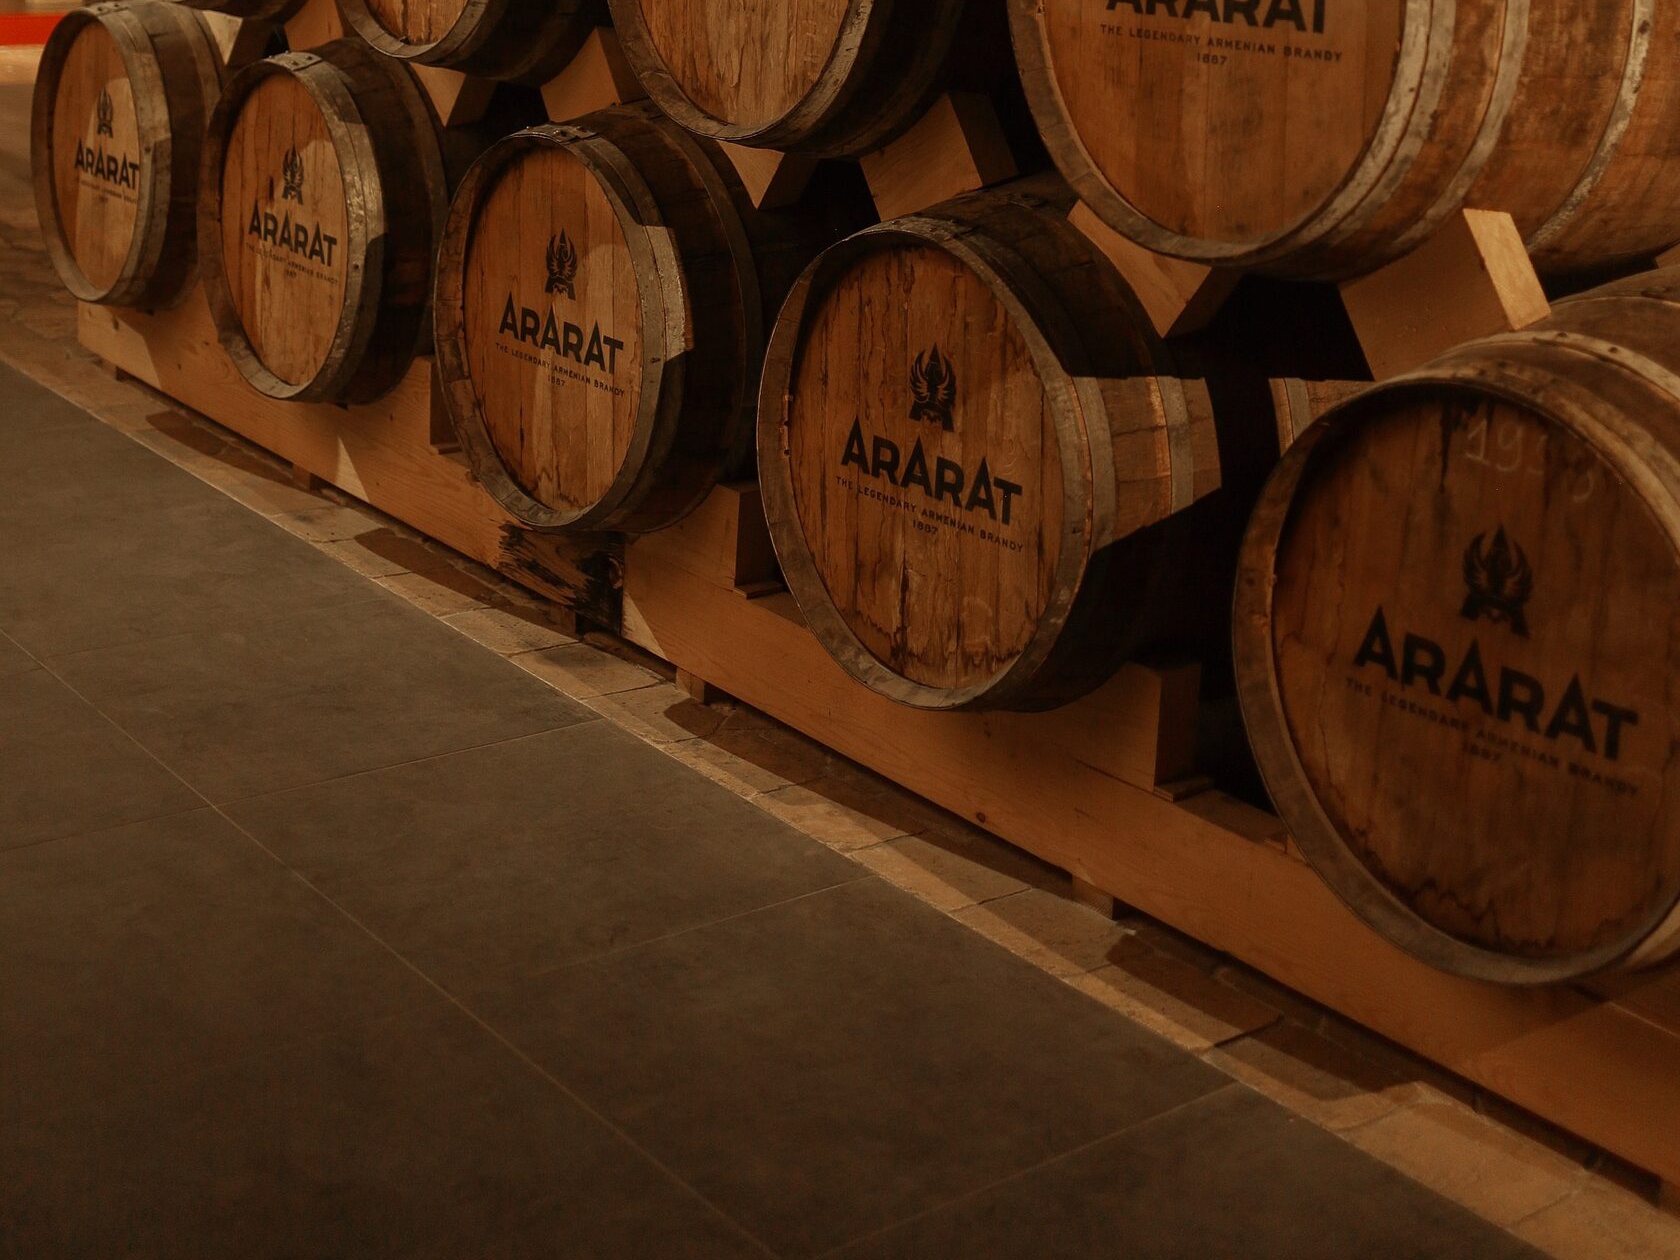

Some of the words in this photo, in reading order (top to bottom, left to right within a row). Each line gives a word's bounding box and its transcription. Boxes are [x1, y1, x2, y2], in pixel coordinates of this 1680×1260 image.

[1100, 24, 1122, 36] THE
[1129, 27, 1200, 46] LEGENDARY
[1207, 36, 1276, 54] ARMENIAN
[1283, 45, 1342, 62] BRANDY
[1196, 53, 1228, 65] 1887
[75, 138, 139, 189] ARARAT
[249, 198, 337, 267] ARARAT
[499, 290, 624, 374] ARARAT
[496, 342, 508, 353] THE
[511, 349, 551, 368] LEGENDARY
[554, 364, 590, 385] ARMENIAN
[594, 379, 625, 397] BRANDY
[548, 375, 566, 386] 1887
[841, 414, 1023, 526] ARARAT
[836, 475, 853, 490] THE
[857, 485, 917, 513] LEGENDARY
[921, 508, 975, 535] ARMENIAN
[980, 529, 1024, 553] BRANDY
[912, 518, 939, 536] 1887
[1354, 604, 1639, 761] ARARAT
